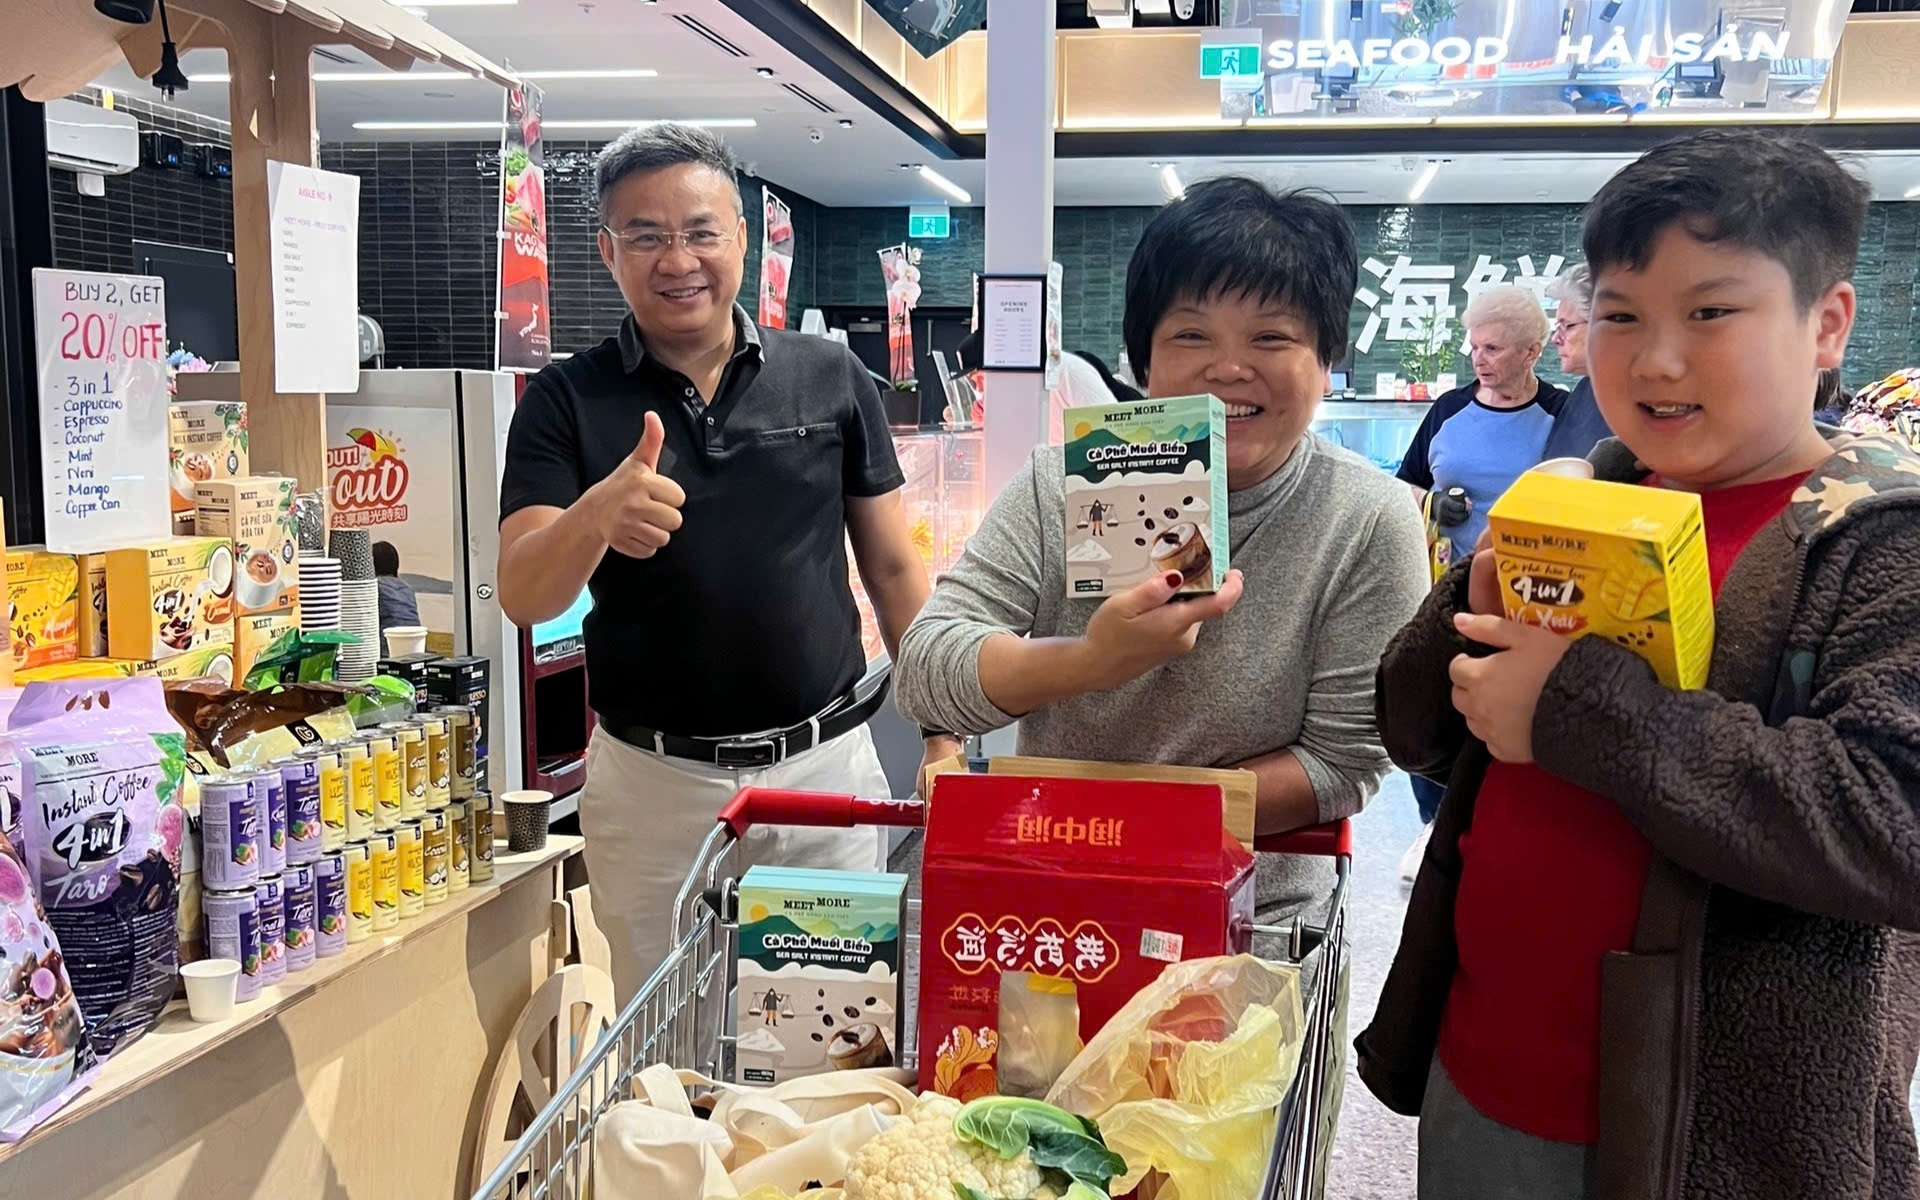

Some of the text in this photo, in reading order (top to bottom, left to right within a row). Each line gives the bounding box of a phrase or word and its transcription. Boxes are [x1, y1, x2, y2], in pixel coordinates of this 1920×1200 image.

[1267, 23, 1791, 70] SEAFOOD HẢI SẢN
[65, 282, 162, 306] BUY 2, GET
[61, 312, 163, 364] 20% OFF
[67, 371, 113, 396] 3 in 1
[171, 410, 189, 419] MEET
[1104, 404, 1165, 422] MEET MORE
[65, 415, 109, 433] Espresso
[187, 419, 205, 428] MORE
[66, 430, 105, 445] Coconut
[69, 448, 93, 463] Mint
[1128, 459, 1155, 468] INSTANT
[1156, 458, 1179, 466] COFFEE
[335, 459, 405, 505] out
[69, 483, 110, 500] Mango
[240, 491, 258, 500] MEET
[101, 499, 121, 510] Can
[256, 499, 274, 509] MORE
[1501, 533, 1586, 552] MEET MORE
[150, 548, 169, 559] MEET
[167, 556, 186, 566] MORE
[252, 617, 273, 630] MEET
[137, 660, 158, 671] MEET
[157, 667, 178, 677] MORE
[65, 752, 99, 767] MORE
[42, 781, 98, 830] Instant
[103, 773, 151, 806] Coffee
[1017, 814, 1125, 846] 润中润
[56, 807, 126, 870] 4in1
[44, 874, 110, 908] Taro
[783, 897, 850, 911] MEET MORE
[764, 936, 779, 948] Cà
[783, 935, 807, 947] Phê
[954, 925, 1106, 971] 枇杷沁润
[776, 951, 866, 963] SEA SALT INSTANT COFFEE
